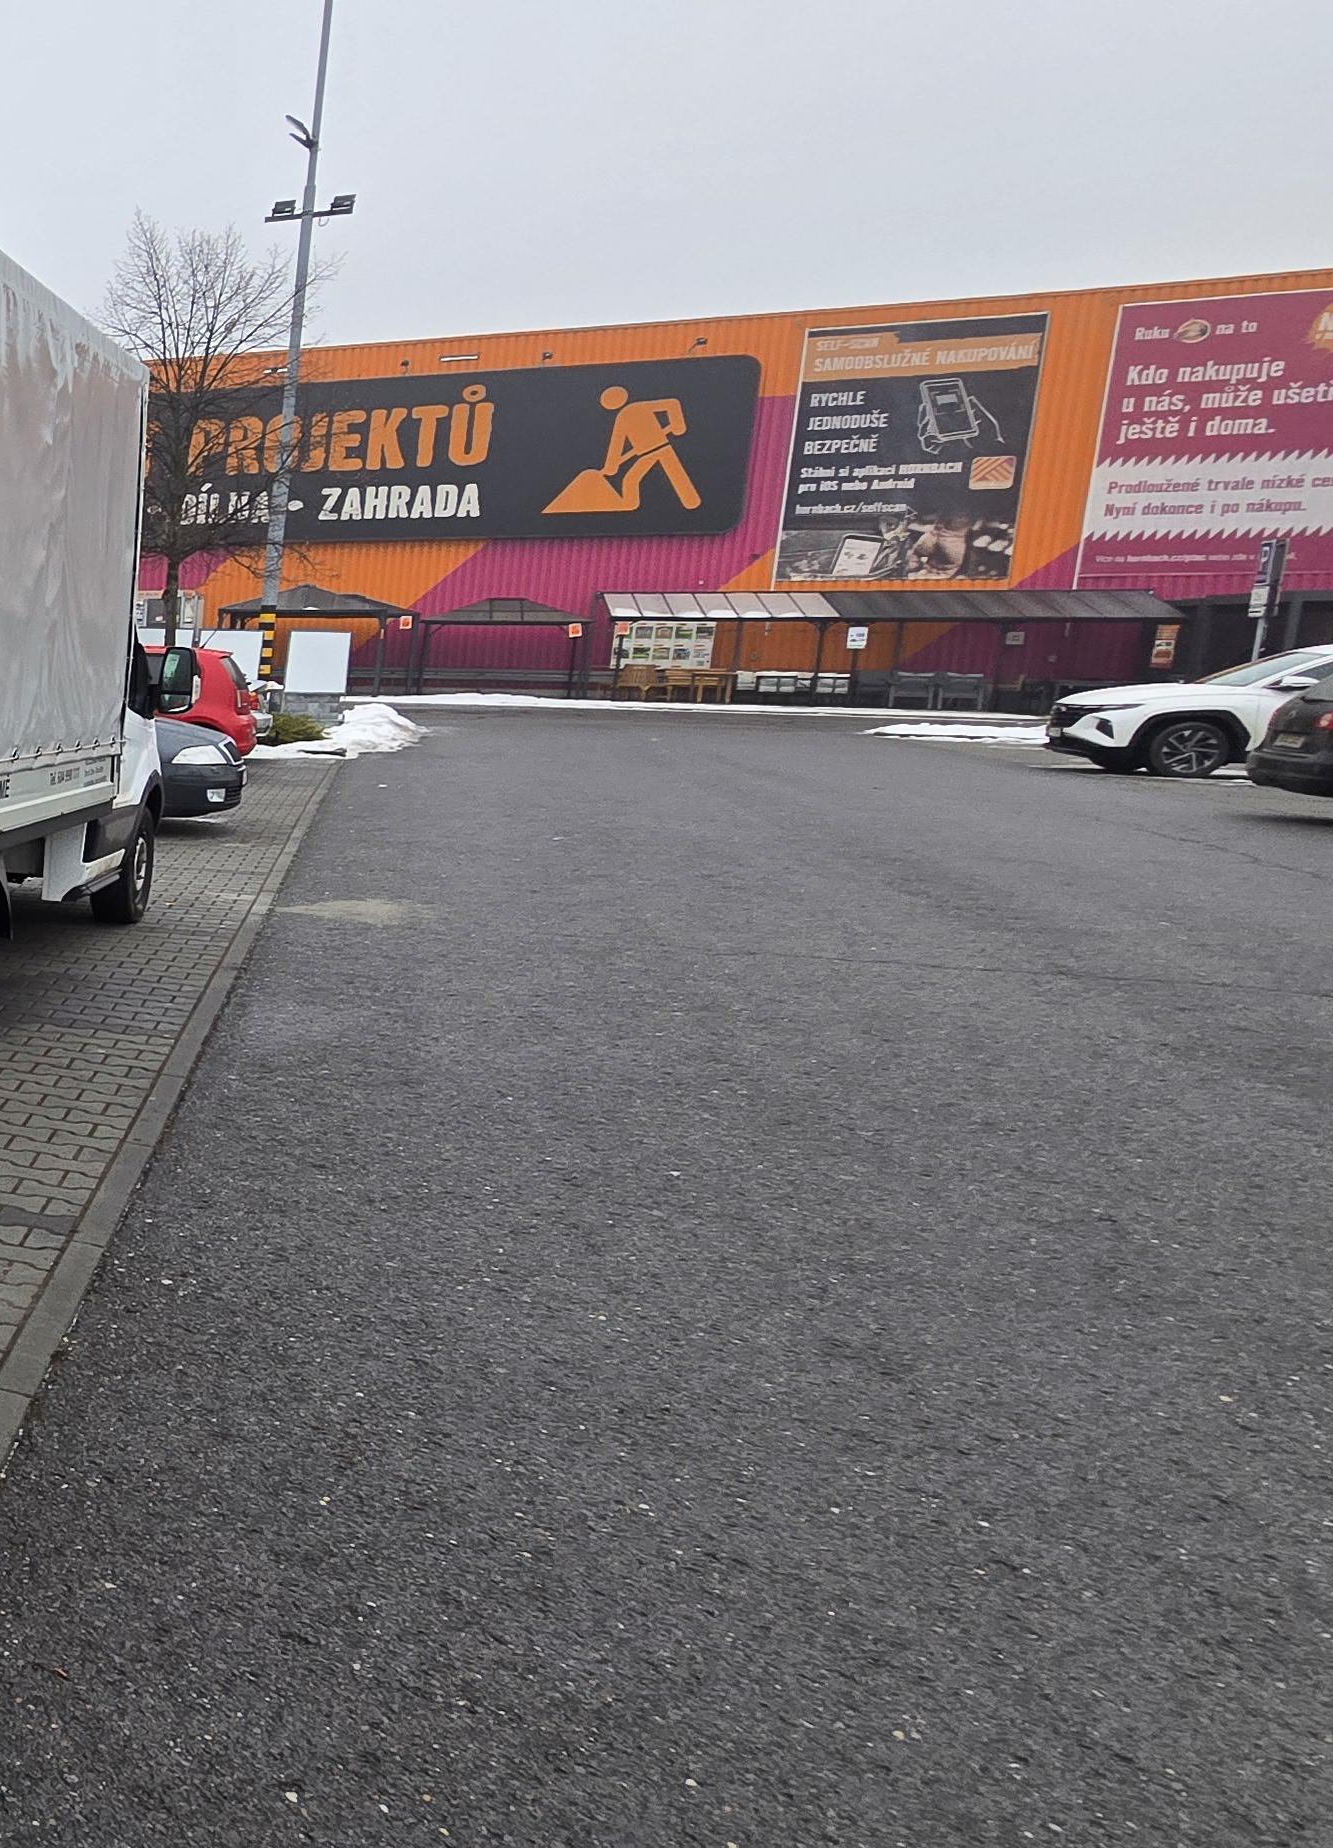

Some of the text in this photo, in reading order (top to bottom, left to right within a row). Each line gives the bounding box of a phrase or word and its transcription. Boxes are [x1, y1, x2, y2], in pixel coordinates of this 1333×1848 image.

[1215, 324, 1234, 335] na
[1241, 320, 1258, 334] to
[813, 339, 1037, 372] SAMOOBSLUŽNÉ NAKUPOVÁNÍ
[1125, 357, 1286, 386] Kdo nakupuje
[810, 390, 866, 408] RYCHLE
[1121, 396, 1136, 413] u
[1142, 389, 1191, 413] nás,
[1200, 384, 1263, 409] může
[187, 384, 494, 476] PROJEKTŮ
[806, 409, 890, 431] JEDNODUŠE
[1116, 415, 1278, 445] ještě i doma.
[803, 434, 878, 455] BEZPEČNĚ
[1106, 478, 1201, 495] Prodloužené
[1207, 476, 1255, 492] trvale
[1261, 473, 1306, 489] nízké
[317, 483, 481, 521] ZAHRADA
[1104, 501, 1137, 520] Nyní
[1141, 501, 1204, 516] dokonce
[1209, 500, 1215, 514] i
[1220, 503, 1240, 517] po
